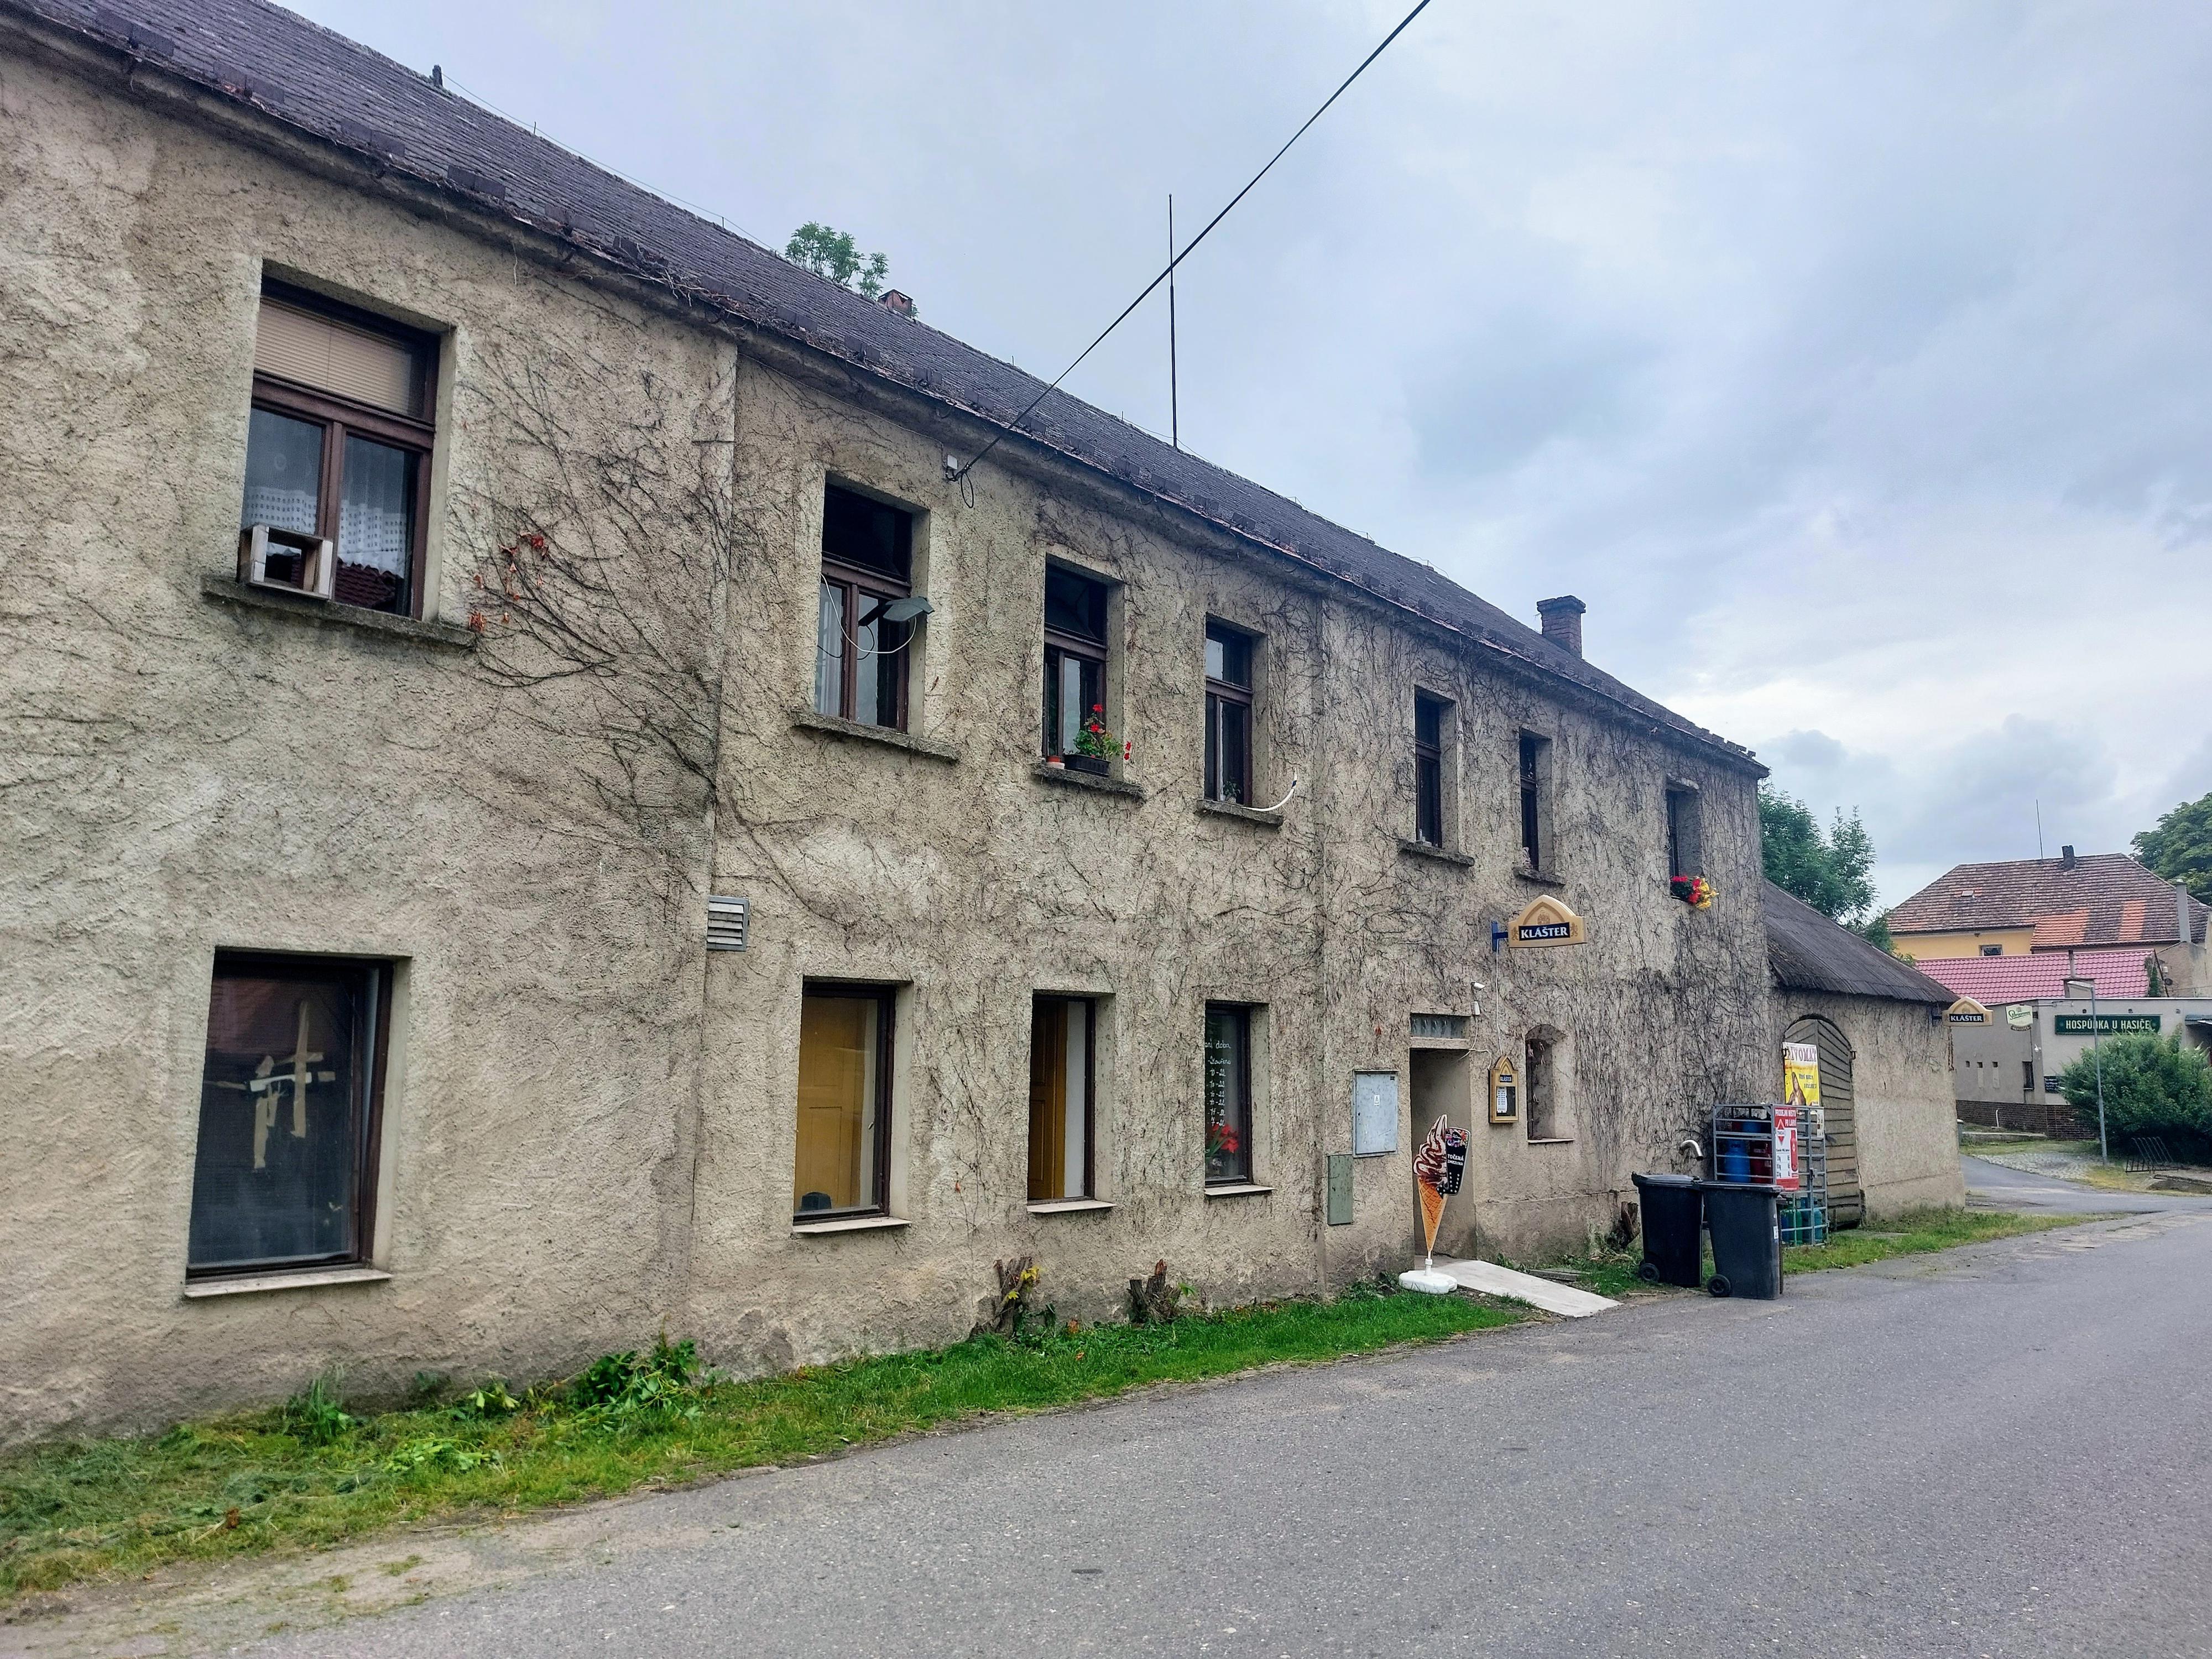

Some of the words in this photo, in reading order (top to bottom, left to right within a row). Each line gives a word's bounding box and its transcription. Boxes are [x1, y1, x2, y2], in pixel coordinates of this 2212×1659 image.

[1521, 926, 1568, 939] KLÁŠTER
[2112, 1020, 2117, 1029] U
[1215, 1040, 1232, 1049] doba
